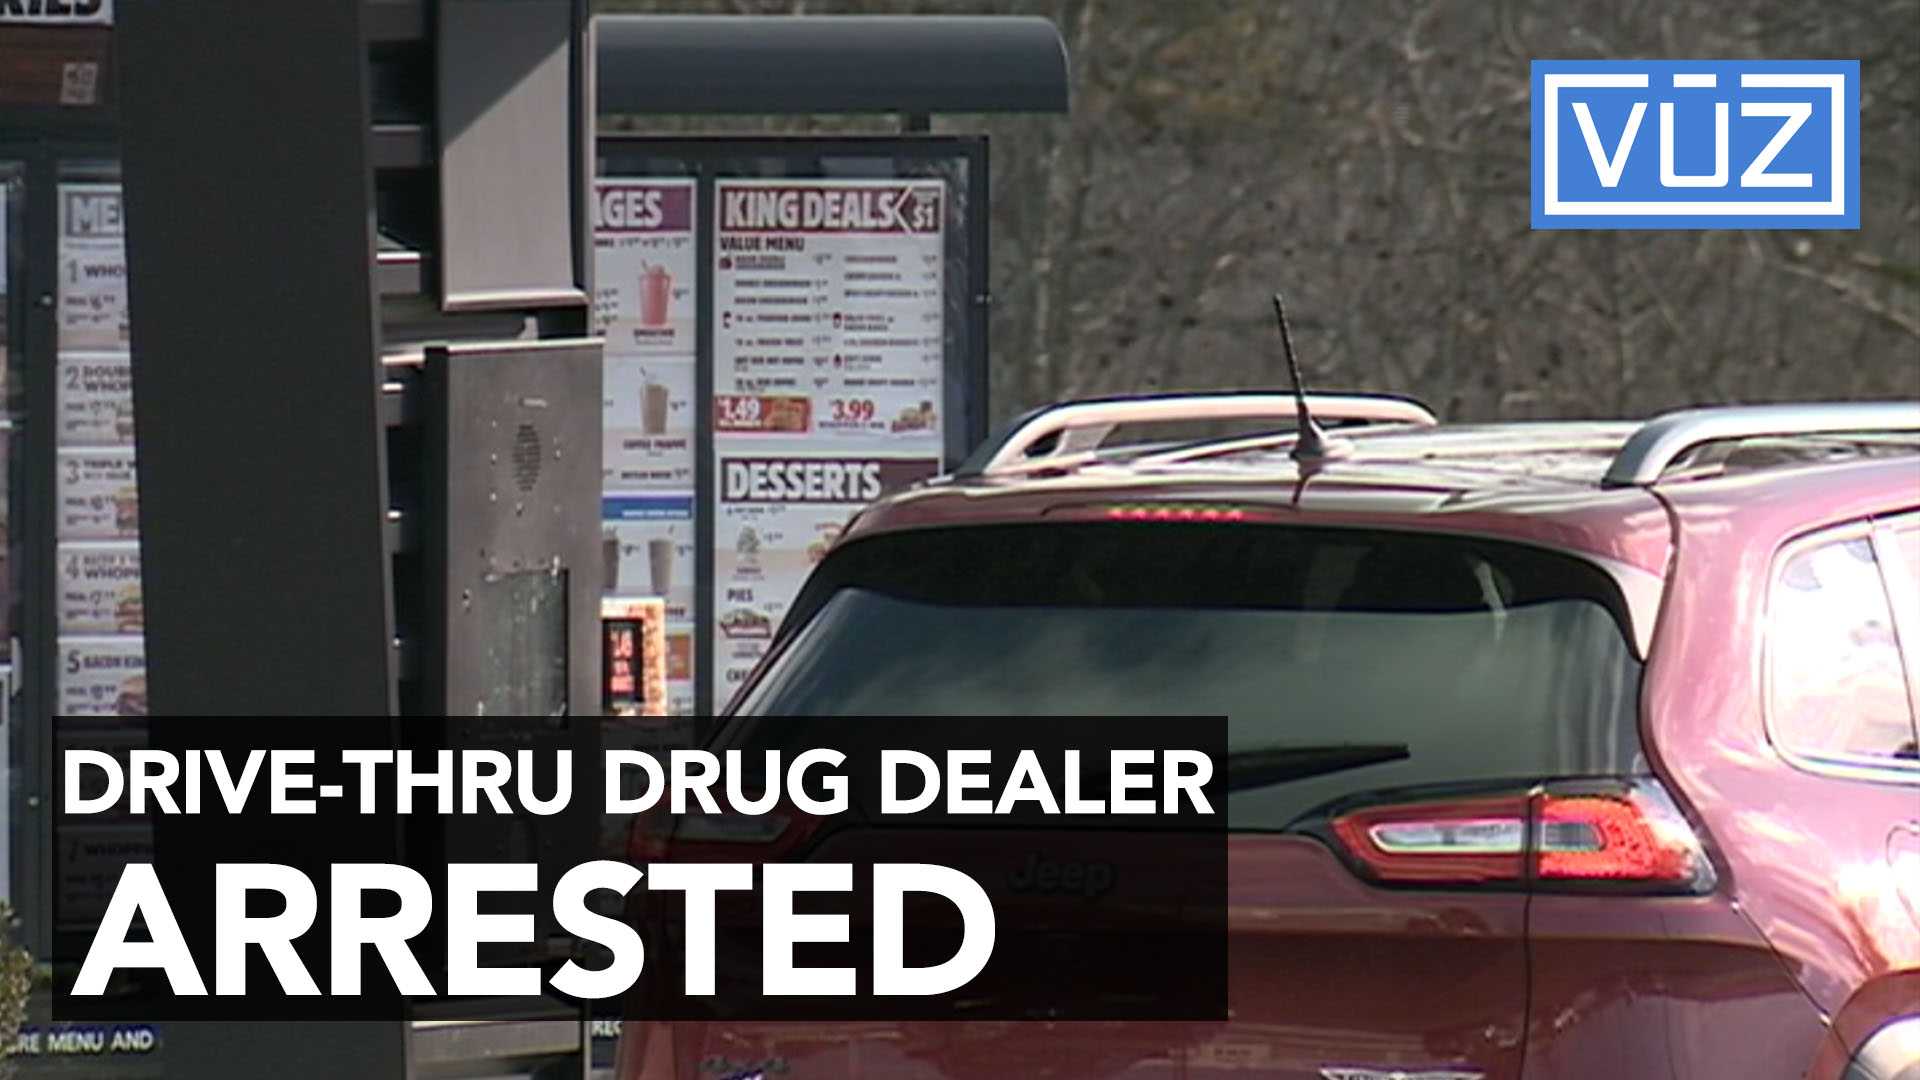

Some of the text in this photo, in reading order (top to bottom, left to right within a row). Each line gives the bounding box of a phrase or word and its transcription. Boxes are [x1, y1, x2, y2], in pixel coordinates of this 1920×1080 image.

[725, 191, 894, 228] KING DEALS
[913, 204, 934, 227] $1
[721, 237, 805, 251] VALUE MENU
[65, 365, 80, 390] 2
[65, 459, 80, 484] 3
[726, 462, 882, 499] DESSERTS
[727, 588, 754, 602] PIES
[66, 650, 81, 674] 5
[1008, 853, 1113, 896] Jeep
[48, 1033, 104, 1051] MENU
[111, 1030, 154, 1050] AND
